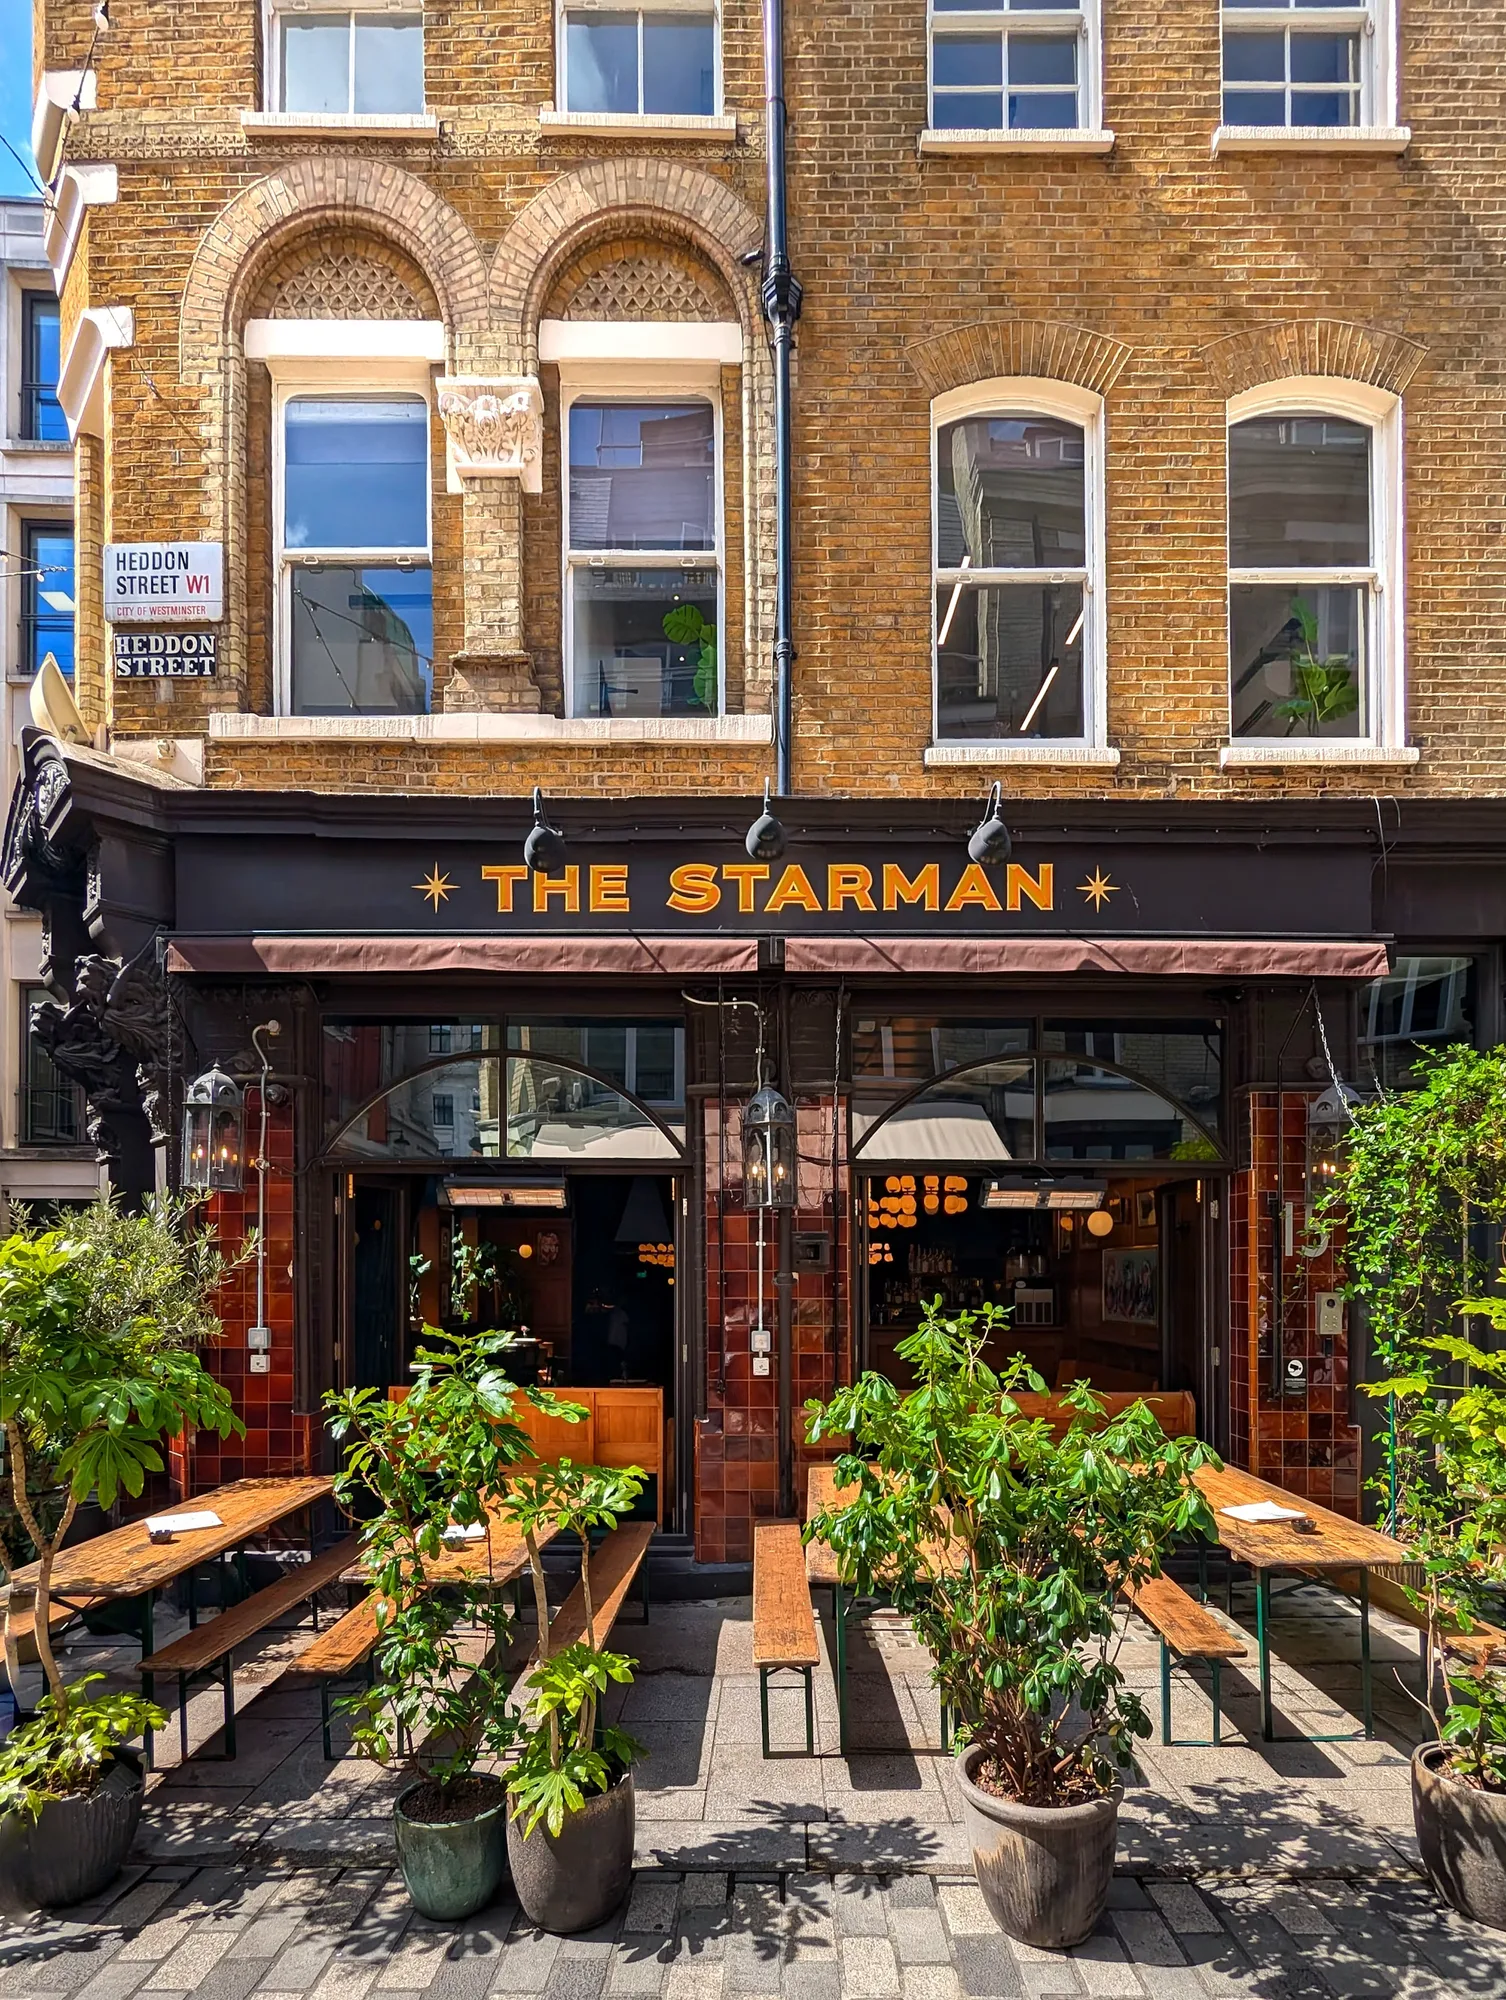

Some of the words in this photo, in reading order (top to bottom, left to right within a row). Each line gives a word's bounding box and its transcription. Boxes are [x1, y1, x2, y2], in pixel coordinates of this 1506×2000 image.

[116, 551, 189, 571] HEDDON
[116, 575, 180, 595] STREET
[186, 575, 210, 594] W1
[117, 606, 135, 617] CITY
[137, 606, 148, 616] OF
[150, 605, 206, 616] WESTMINSTER
[115, 635, 216, 655] HEDDON
[117, 657, 216, 676] STREET
[480, 863, 630, 913] THE
[665, 862, 1054, 913] STARMAN
[1285, 1202, 1329, 1258] 15
